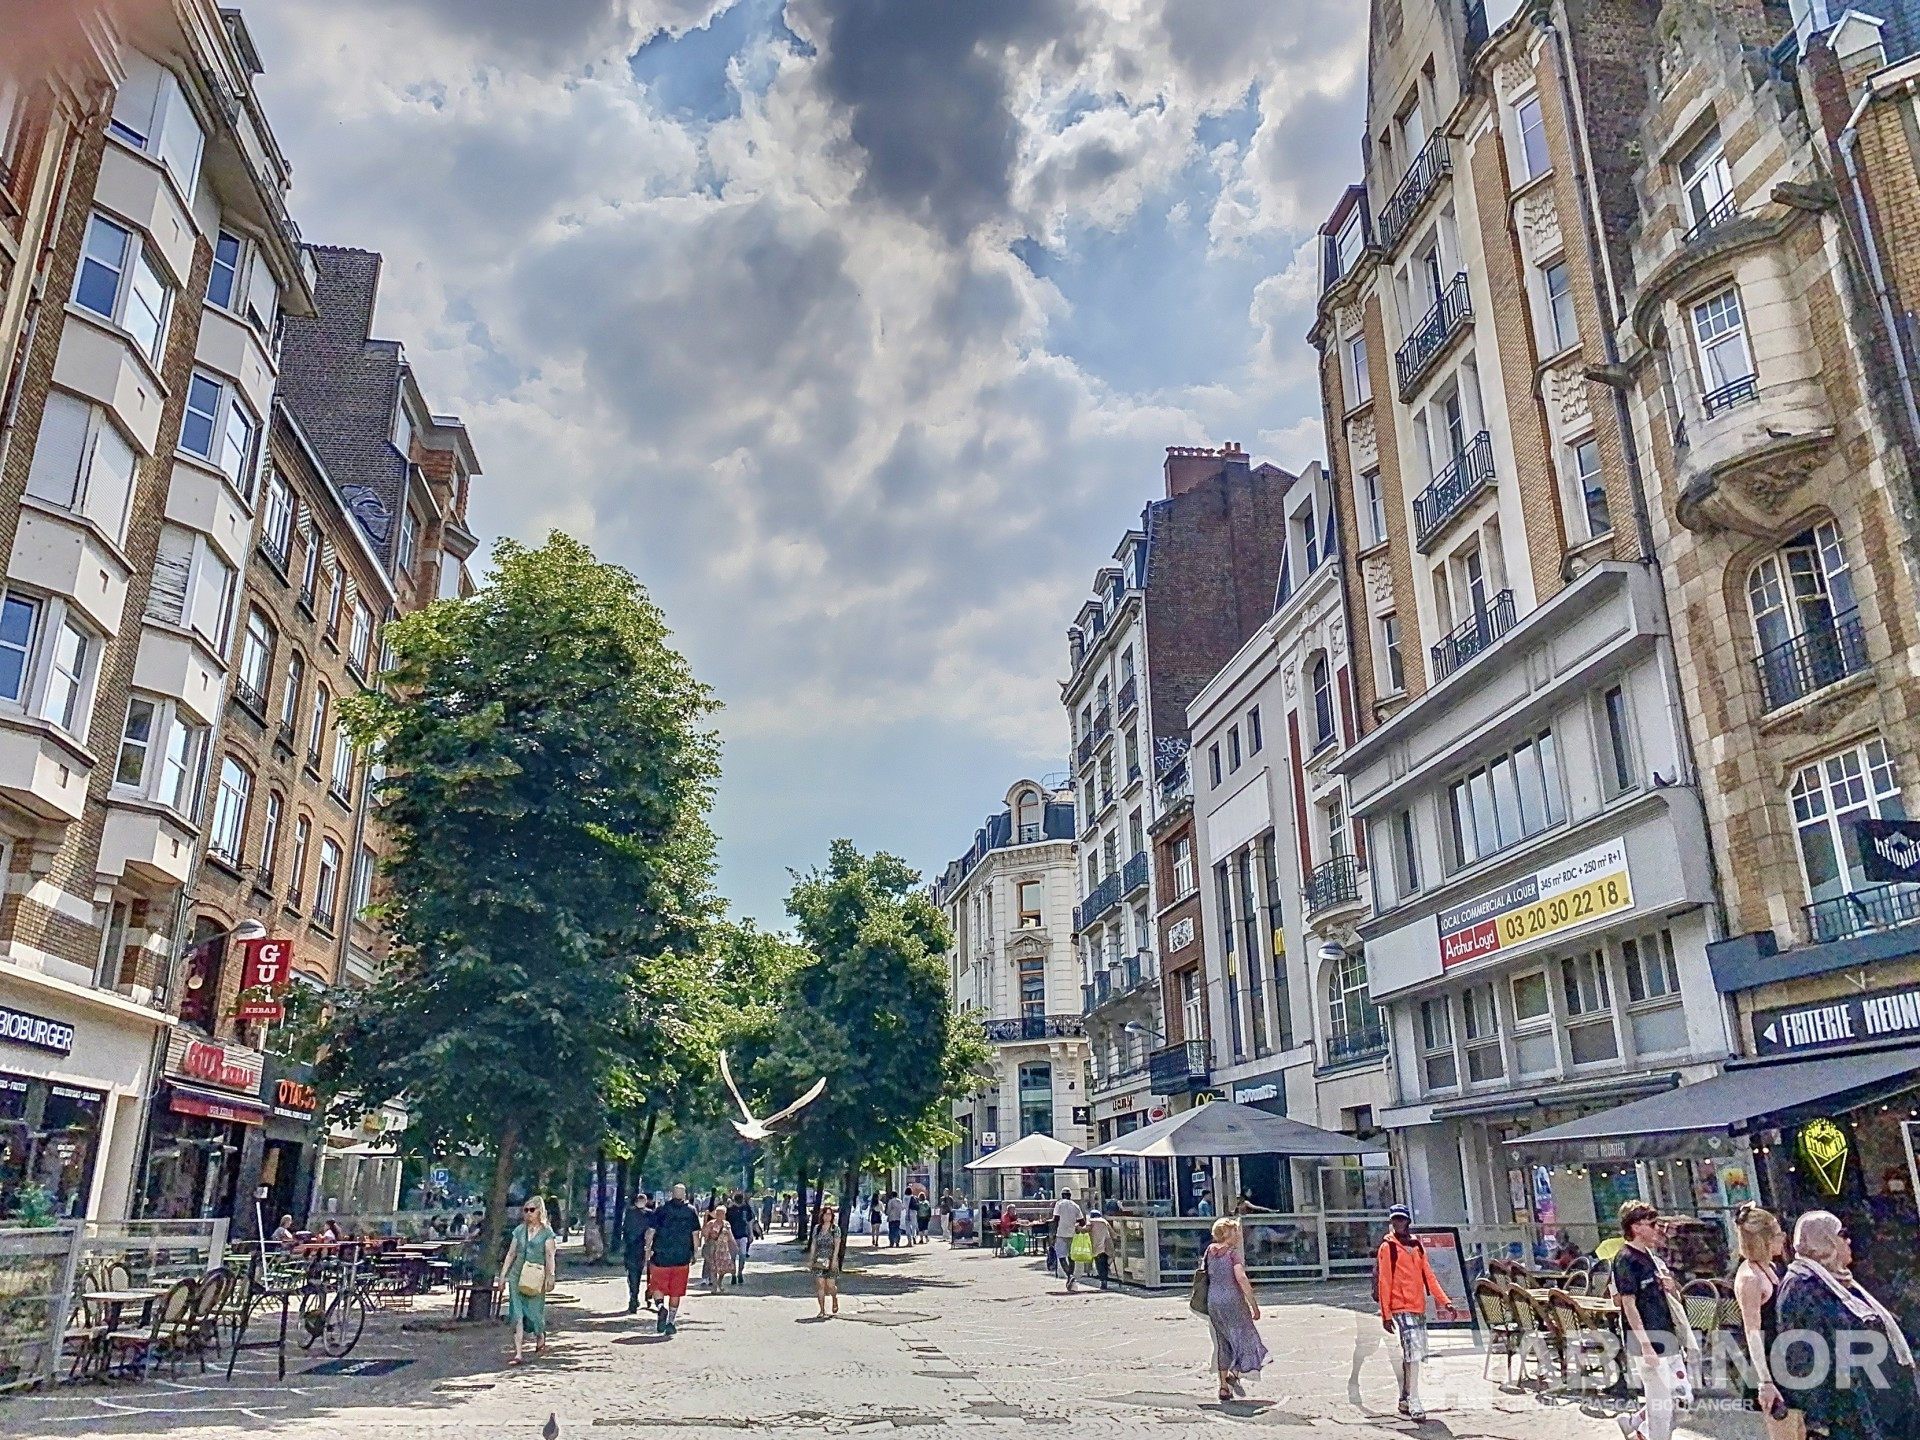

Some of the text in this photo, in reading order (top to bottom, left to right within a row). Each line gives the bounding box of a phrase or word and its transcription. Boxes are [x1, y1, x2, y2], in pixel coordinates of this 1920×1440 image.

[1540, 877, 1552, 891] 345
[1563, 867, 1578, 883] RDC
[1583, 859, 1597, 875] 250
[1608, 850, 1622, 865] R+1
[1440, 882, 1537, 931] LOCAL COMMERCIAL A LOUER
[1506, 881, 1619, 939] 03 20 30 22 18
[1446, 928, 1495, 960] Arthur Loyd
[0, 1010, 73, 1051] BIOBURGER
[1781, 1003, 1855, 1048] FRITERIE
